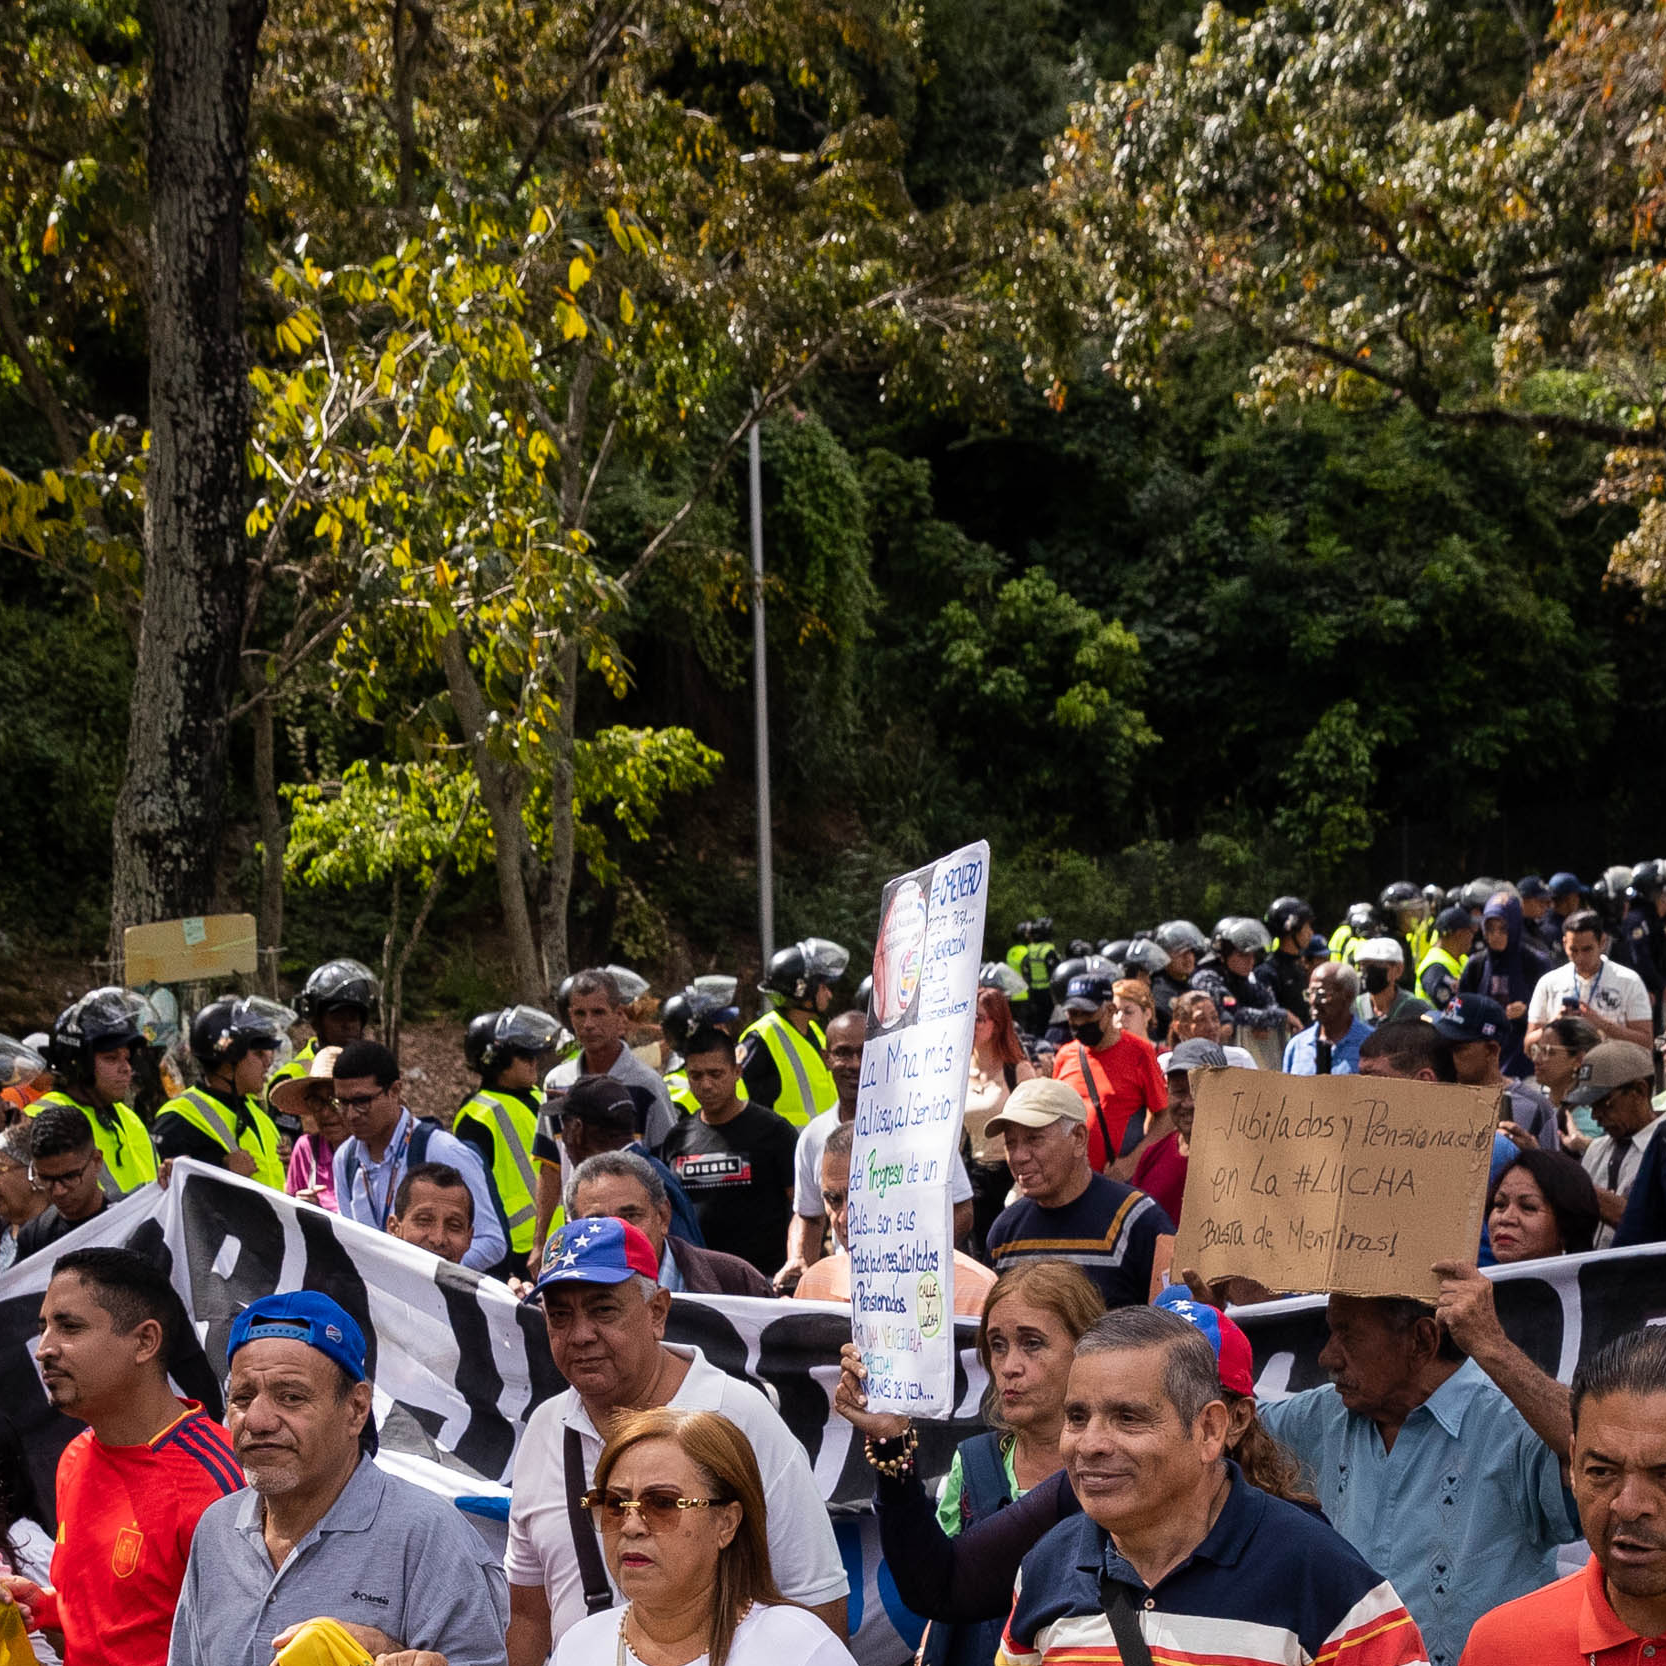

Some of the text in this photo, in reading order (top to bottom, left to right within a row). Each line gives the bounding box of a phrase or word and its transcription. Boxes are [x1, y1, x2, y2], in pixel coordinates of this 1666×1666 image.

[861, 1051, 877, 1089] La
[886, 1040, 919, 1083] Mina
[1215, 1091, 1334, 1144] Jubilados
[1354, 1100, 1491, 1152] Pensionados
[685, 1161, 736, 1175] DIESEL
[849, 1149, 938, 1199] del Progreso de un
[1211, 1155, 1415, 1203] en La #LUCHA
[877, 1213, 892, 1235] son
[897, 1210, 916, 1232] sus
[1253, 1215, 1274, 1252] de
[919, 1284, 937, 1299] CALLE
[926, 1301, 932, 1312] Y
